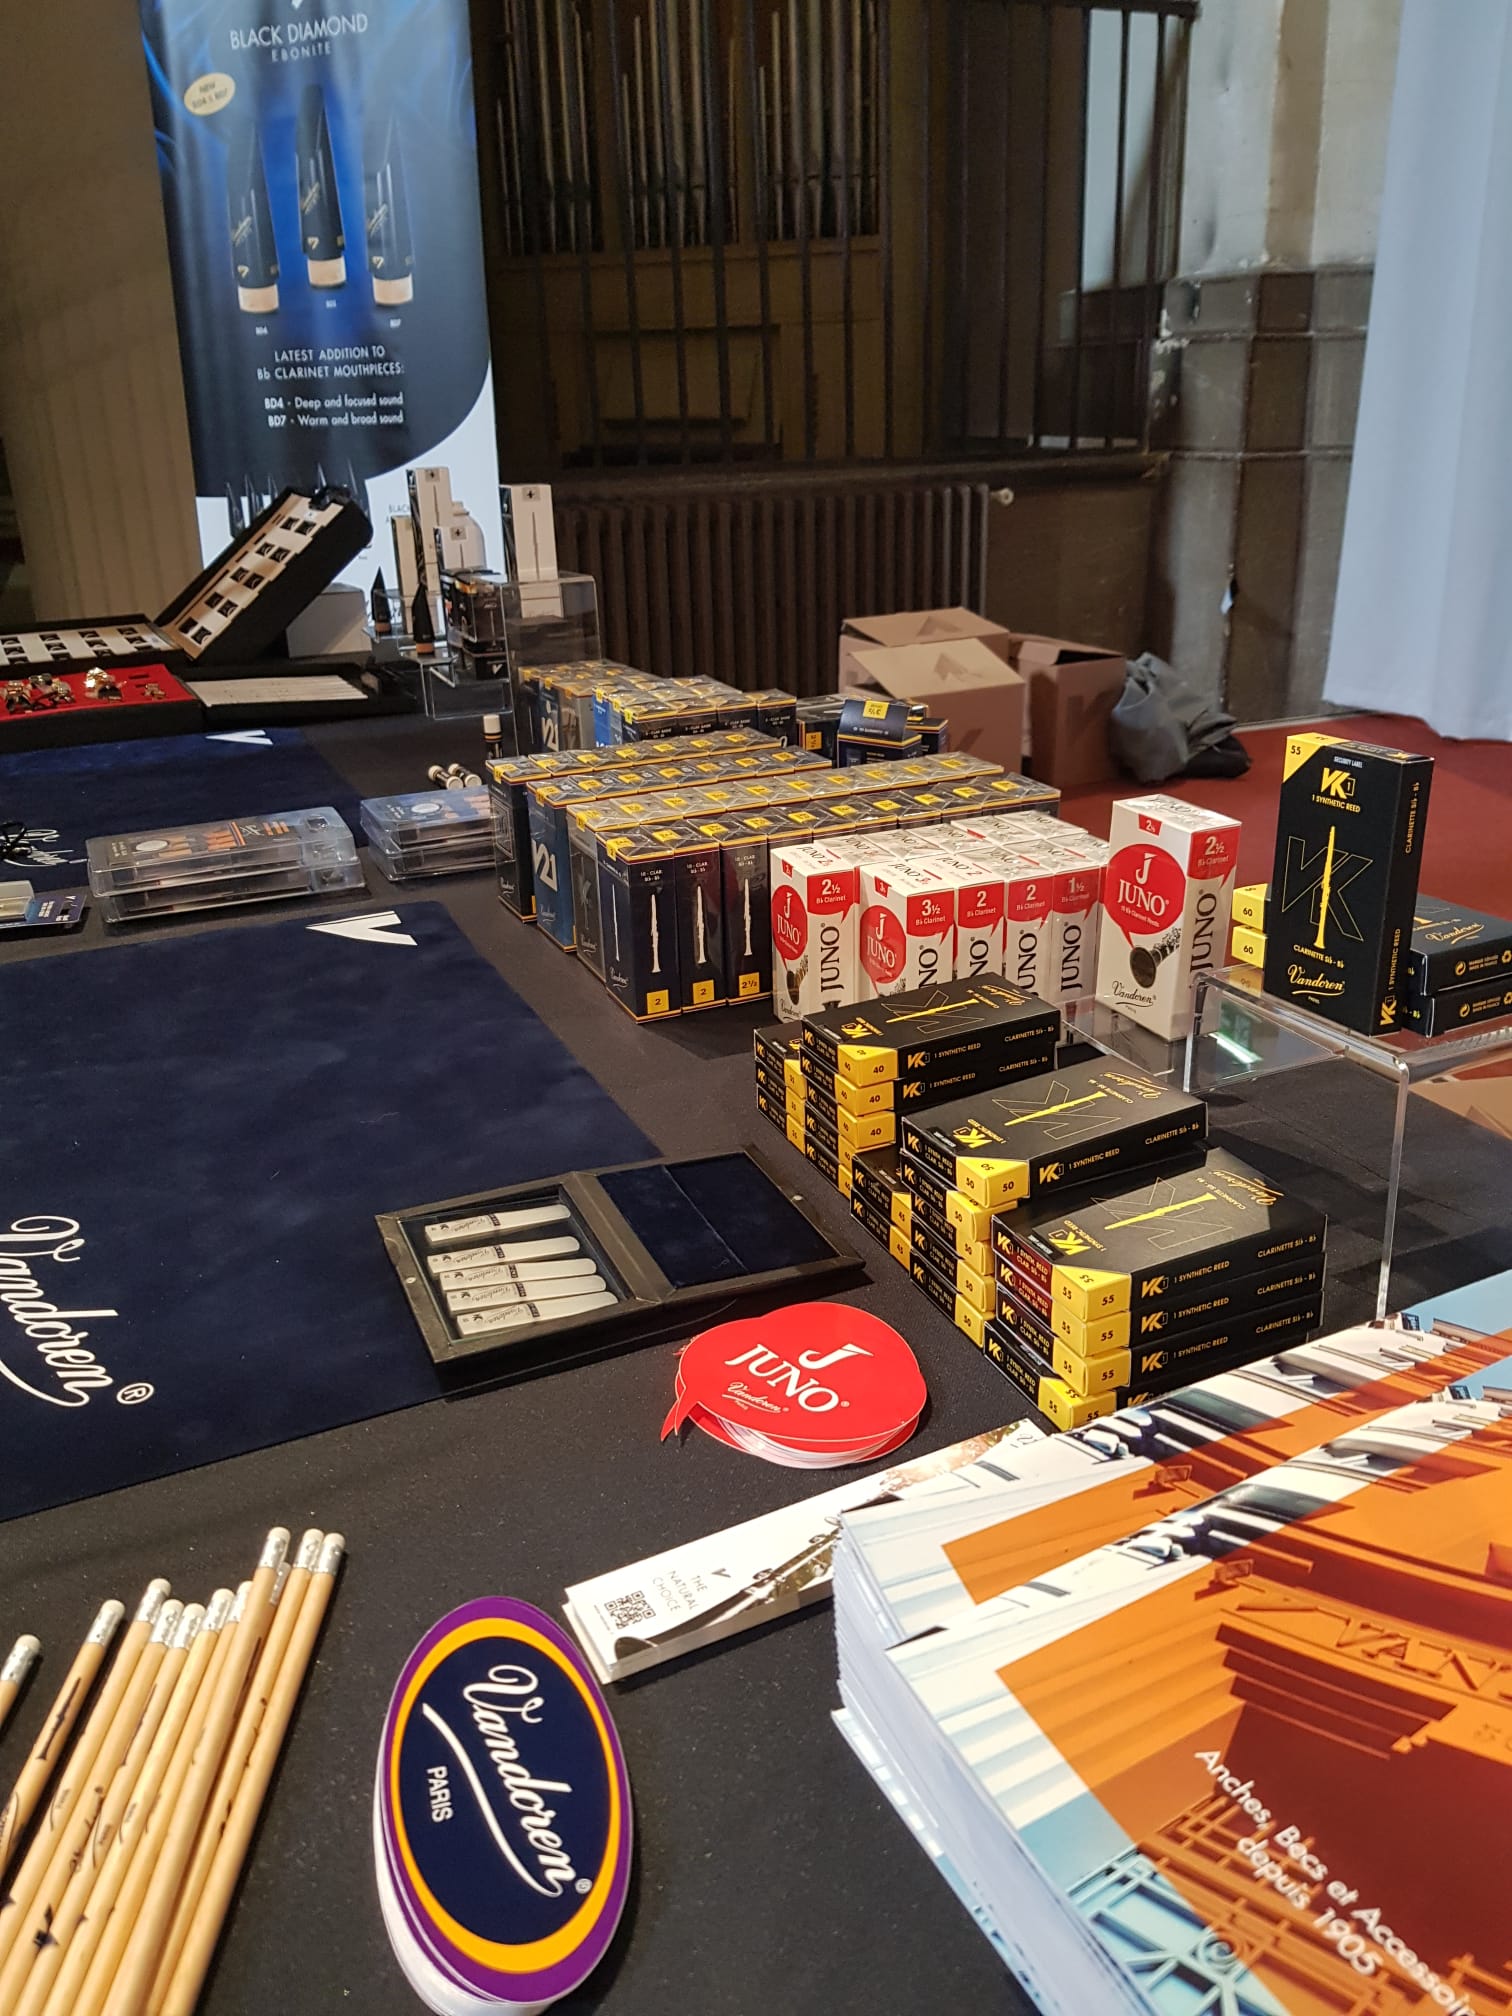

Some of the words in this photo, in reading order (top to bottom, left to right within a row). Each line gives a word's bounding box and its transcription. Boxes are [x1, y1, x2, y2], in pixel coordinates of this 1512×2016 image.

[229, 24, 283, 50] BLACK
[287, 13, 368, 44] DIAMOND
[271, 41, 332, 62] EBONITE
[274, 350, 314, 362] LATEST
[319, 346, 369, 361] ADDITION
[372, 345, 385, 357] TO
[257, 367, 271, 380] Bb
[274, 366, 329, 380] CLARINET
[264, 397, 284, 409] BD4
[294, 396, 321, 411] Deep
[324, 394, 342, 408] and
[344, 392, 376, 407] focused
[379, 392, 403, 405] sound
[267, 415, 287, 427] BD7
[297, 414, 329, 427] Warm
[331, 412, 349, 425] and
[350, 411, 377, 425] broad
[379, 410, 403, 424] sound
[1291, 745, 1301, 755] 55
[1316, 795, 1345, 809] SYNTHETIC
[1345, 803, 1361, 813] REED
[1405, 806, 1417, 854] CLARINETTE
[1205, 836, 1225, 856] 2½
[821, 879, 841, 895] 2½
[1026, 884, 1036, 901] 2
[1068, 877, 1085, 893] 1½
[976, 890, 987, 907] 2
[1024, 901, 1045, 909] Clarinet
[1118, 879, 1166, 917] JUNO
[921, 899, 941, 917] 3½
[975, 907, 996, 916] Clarinet
[1243, 907, 1253, 917] 60
[924, 916, 945, 924] Clarinet
[777, 914, 800, 945] JUNO
[1190, 892, 1217, 972] JUNO
[1393, 928, 1401, 951] REED
[867, 935, 895, 968] JUNO
[1060, 924, 1083, 992] JUNO
[1243, 945, 1254, 955] 60
[1293, 944, 1324, 960] CLARINETTE
[820, 926, 845, 992] JUNO
[1287, 964, 1345, 991] Vandoren
[1388, 952, 1400, 986] SYNTHETIC
[655, 998, 661, 1006] 2
[1112, 980, 1154, 1008] Vandoren
[1004, 1030, 1035, 1042] CLARINETTE
[938, 1046, 967, 1059] SYNTHETIC
[967, 1042, 981, 1052] REED
[873, 1065, 884, 1074] 40
[999, 1060, 1029, 1073] CLARINETTE
[933, 1075, 961, 1088] SYNTHETIC
[962, 1072, 976, 1082] REED
[869, 1095, 880, 1103] 40
[870, 1128, 882, 1136] 40
[1145, 1128, 1178, 1145] CLARINETTE
[1073, 1153, 1105, 1169] SYNTHETIC
[1105, 1148, 1120, 1158] REED
[966, 1177, 975, 1190] 50
[1002, 1181, 1015, 1193] 50
[954, 1211, 963, 1223] 50
[964, 1243, 972, 1255] 50
[1257, 1240, 1294, 1258] CLARINETTE
[1036, 1260, 1049, 1275] REED
[1178, 1266, 1213, 1283] SYNTHETIC
[1213, 1260, 1230, 1271] REED
[965, 1280, 973, 1292] 50
[1062, 1286, 1072, 1300] 55
[1257, 1278, 1294, 1295] CLARINETTE
[1101, 1294, 1115, 1306] 55
[1178, 1302, 1212, 1318] SYNTHETIC
[1213, 1297, 1229, 1308] REED
[963, 1315, 971, 1327] 50
[1061, 1321, 1071, 1335] 55
[1255, 1317, 1291, 1335] CLARINETTE
[1101, 1330, 1114, 1341] 55
[1178, 1342, 1212, 1358] SYNTHETIC
[1212, 1336, 1229, 1348] REED
[1063, 1360, 1072, 1373] 55
[1101, 1369, 1115, 1381] 55
[724, 1343, 840, 1413] JUNO
[727, 1381, 784, 1413] Vandoren
[1049, 1400, 1058, 1413] 55
[1087, 1410, 1099, 1421] 55
[667, 1570, 700, 1610] NATURAL
[690, 1575, 708, 1592] THE
[652, 1576, 681, 1612] CHOICE
[463, 1664, 577, 1892] Vandoren
[426, 1765, 453, 1824] PARIS
[1194, 1750, 1272, 1830] Anches,
[1275, 1825, 1329, 1882] Becs
[1326, 1878, 1360, 1907] et
[1237, 1836, 1312, 1911] depuis
[1313, 1908, 1384, 1977] 1905
